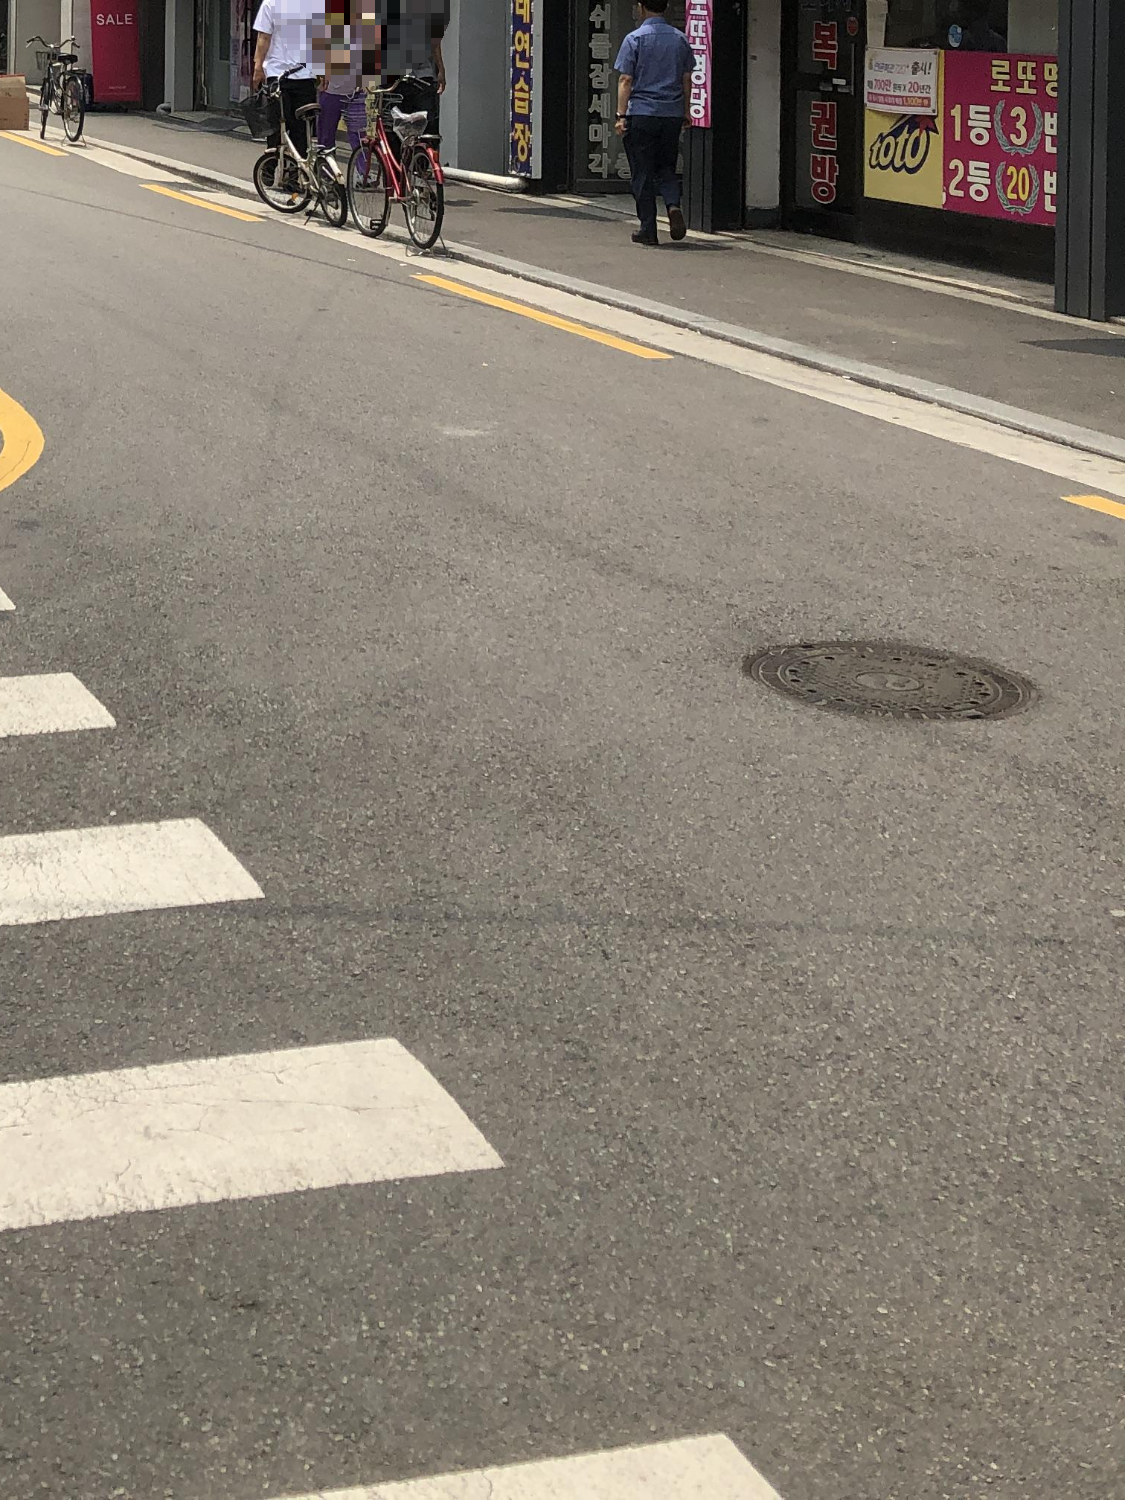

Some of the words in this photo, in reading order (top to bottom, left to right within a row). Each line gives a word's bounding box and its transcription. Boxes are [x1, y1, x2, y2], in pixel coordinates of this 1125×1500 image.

[96, 13, 134, 26] SALE
[810, 20, 839, 204] 복권방
[950, 104, 992, 146] 1등
[1009, 106, 1027, 146] 3
[868, 122, 929, 175] toto
[948, 158, 992, 202] 2등
[1006, 165, 1030, 201] 20
